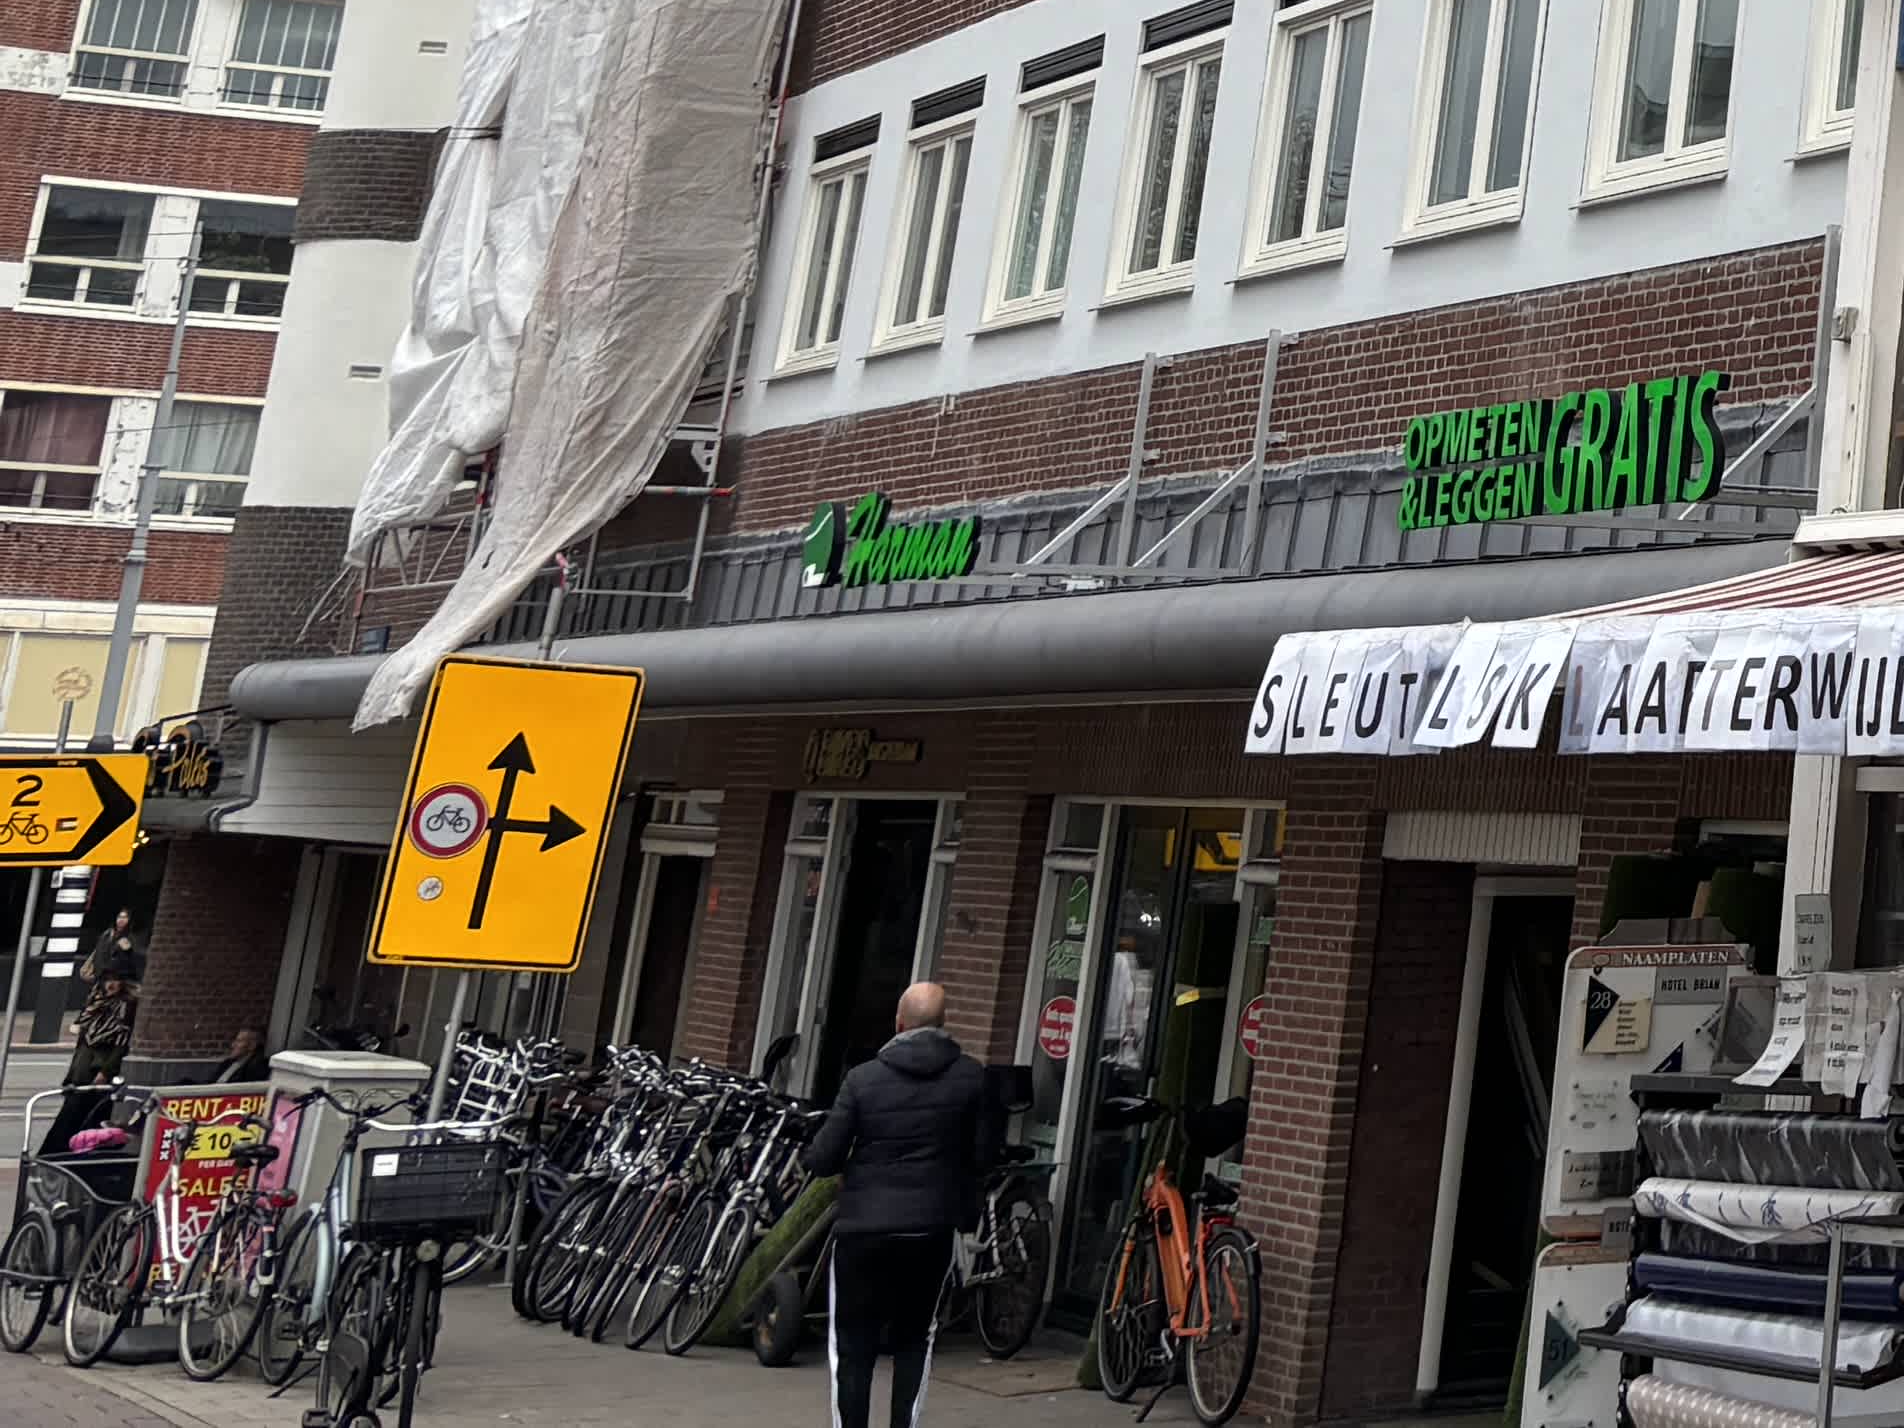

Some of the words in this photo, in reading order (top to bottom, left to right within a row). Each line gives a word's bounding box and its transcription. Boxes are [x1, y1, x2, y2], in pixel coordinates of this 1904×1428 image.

[1403, 400, 1544, 472] OPMETEN
[1543, 370, 1724, 515] GRATIS
[1253, 663, 1508, 740] SLEUTLS
[10, 774, 44, 808] 2
[1622, 951, 1729, 966] NAAMPLATEN
[1590, 991, 1611, 1009] 28
[167, 1097, 224, 1120] RENT
